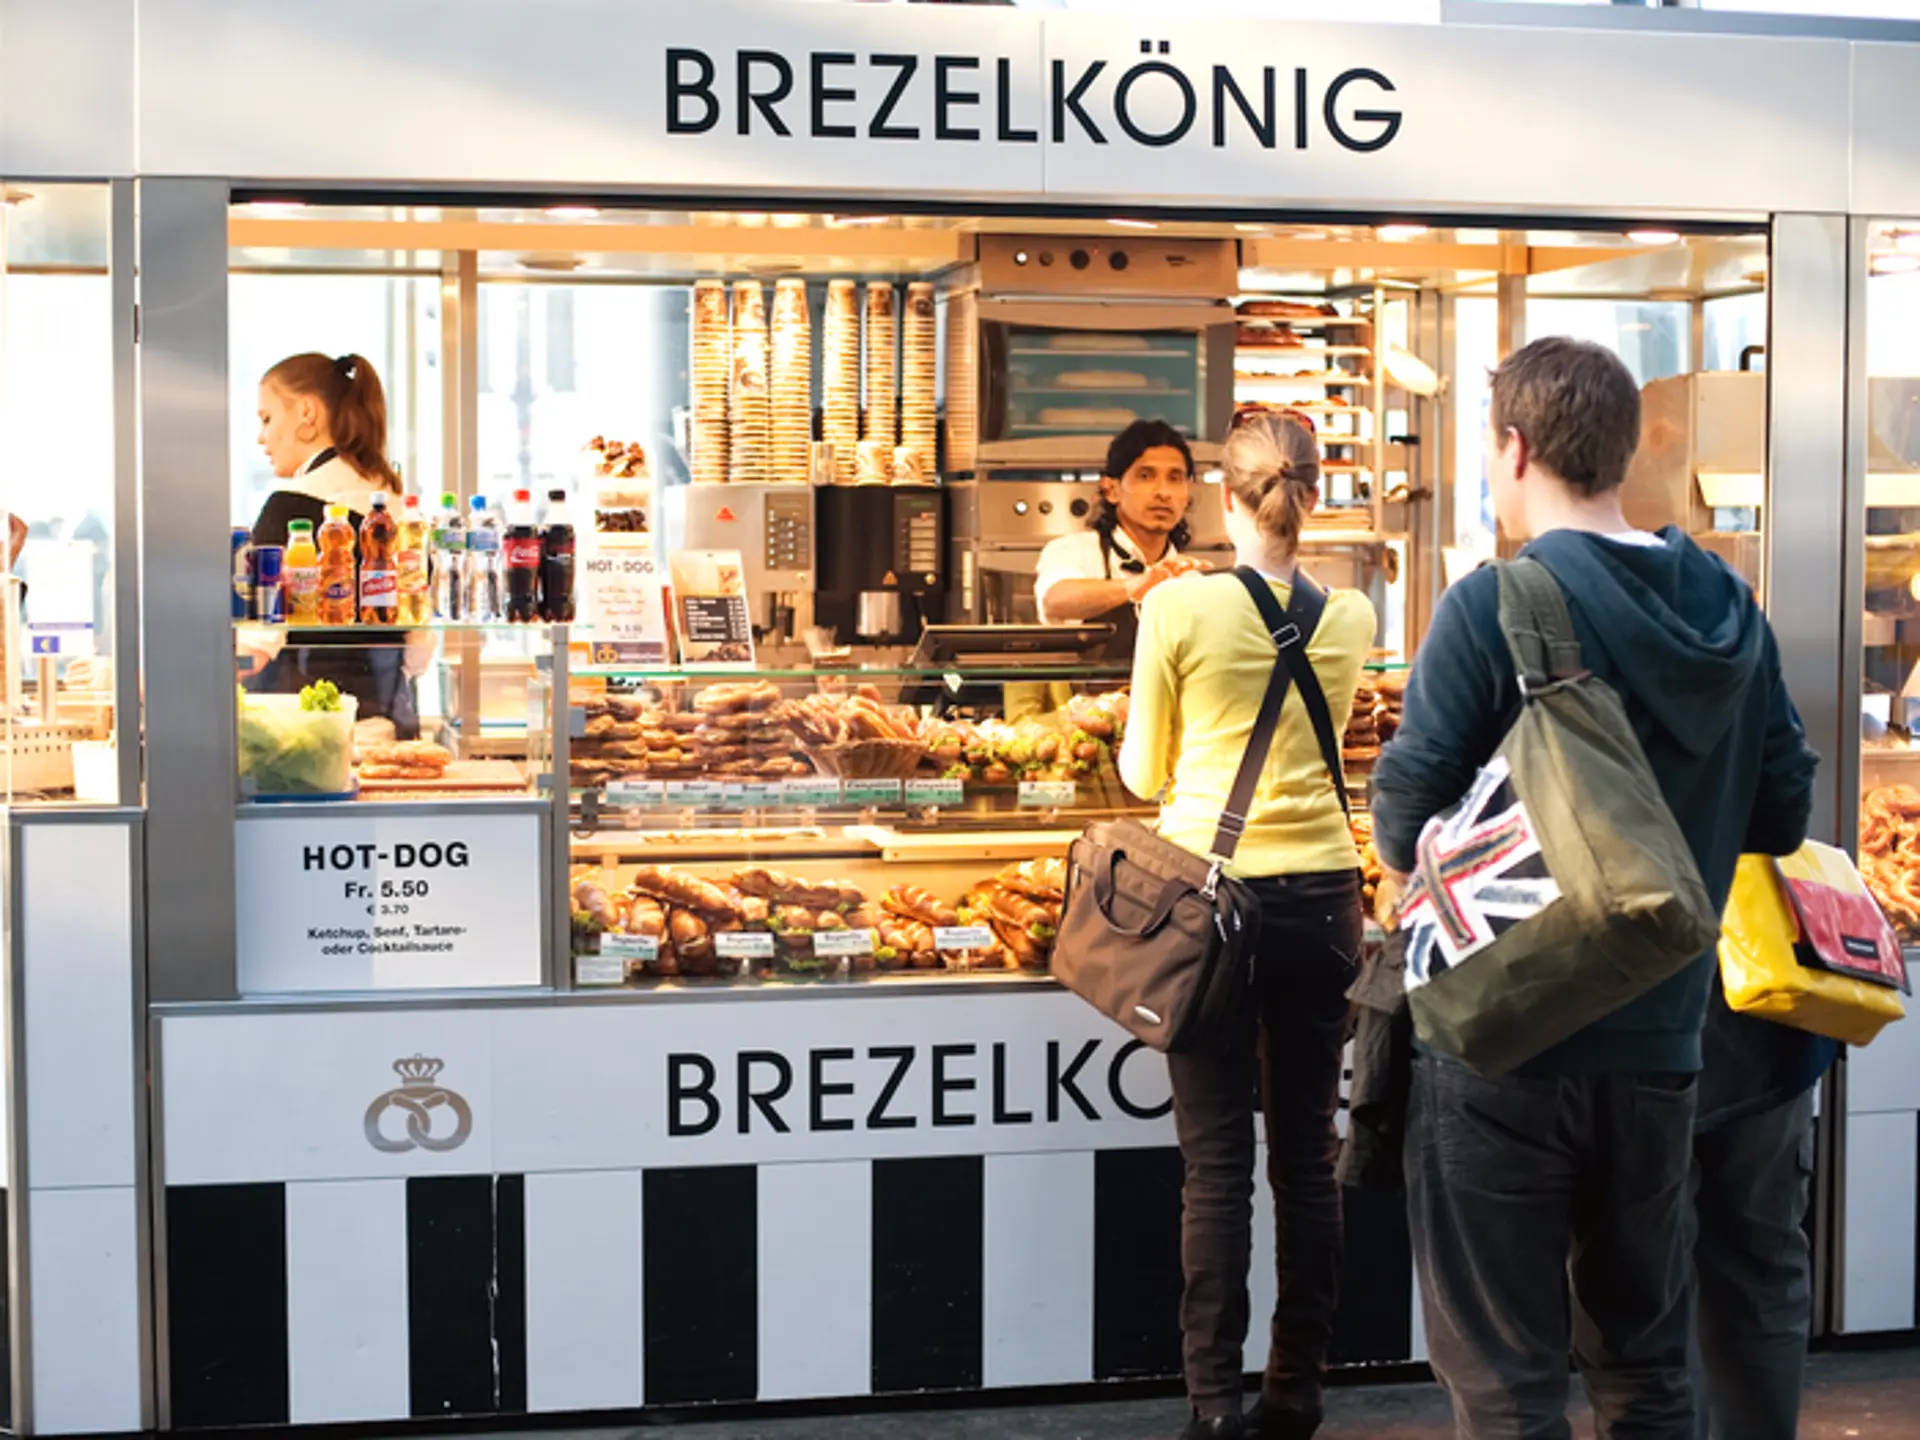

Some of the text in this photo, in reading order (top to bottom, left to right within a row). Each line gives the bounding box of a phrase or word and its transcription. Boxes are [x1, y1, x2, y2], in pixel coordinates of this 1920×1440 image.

[666, 40, 1402, 151] BREZELKÖNIG
[303, 842, 469, 871] HOT-DOG
[344, 881, 373, 899] Fr.
[381, 904, 410, 915] 3.70
[307, 927, 371, 940] Ketchup,
[373, 926, 410, 939] Senf,
[321, 942, 453, 956] oder Cocktailsauce
